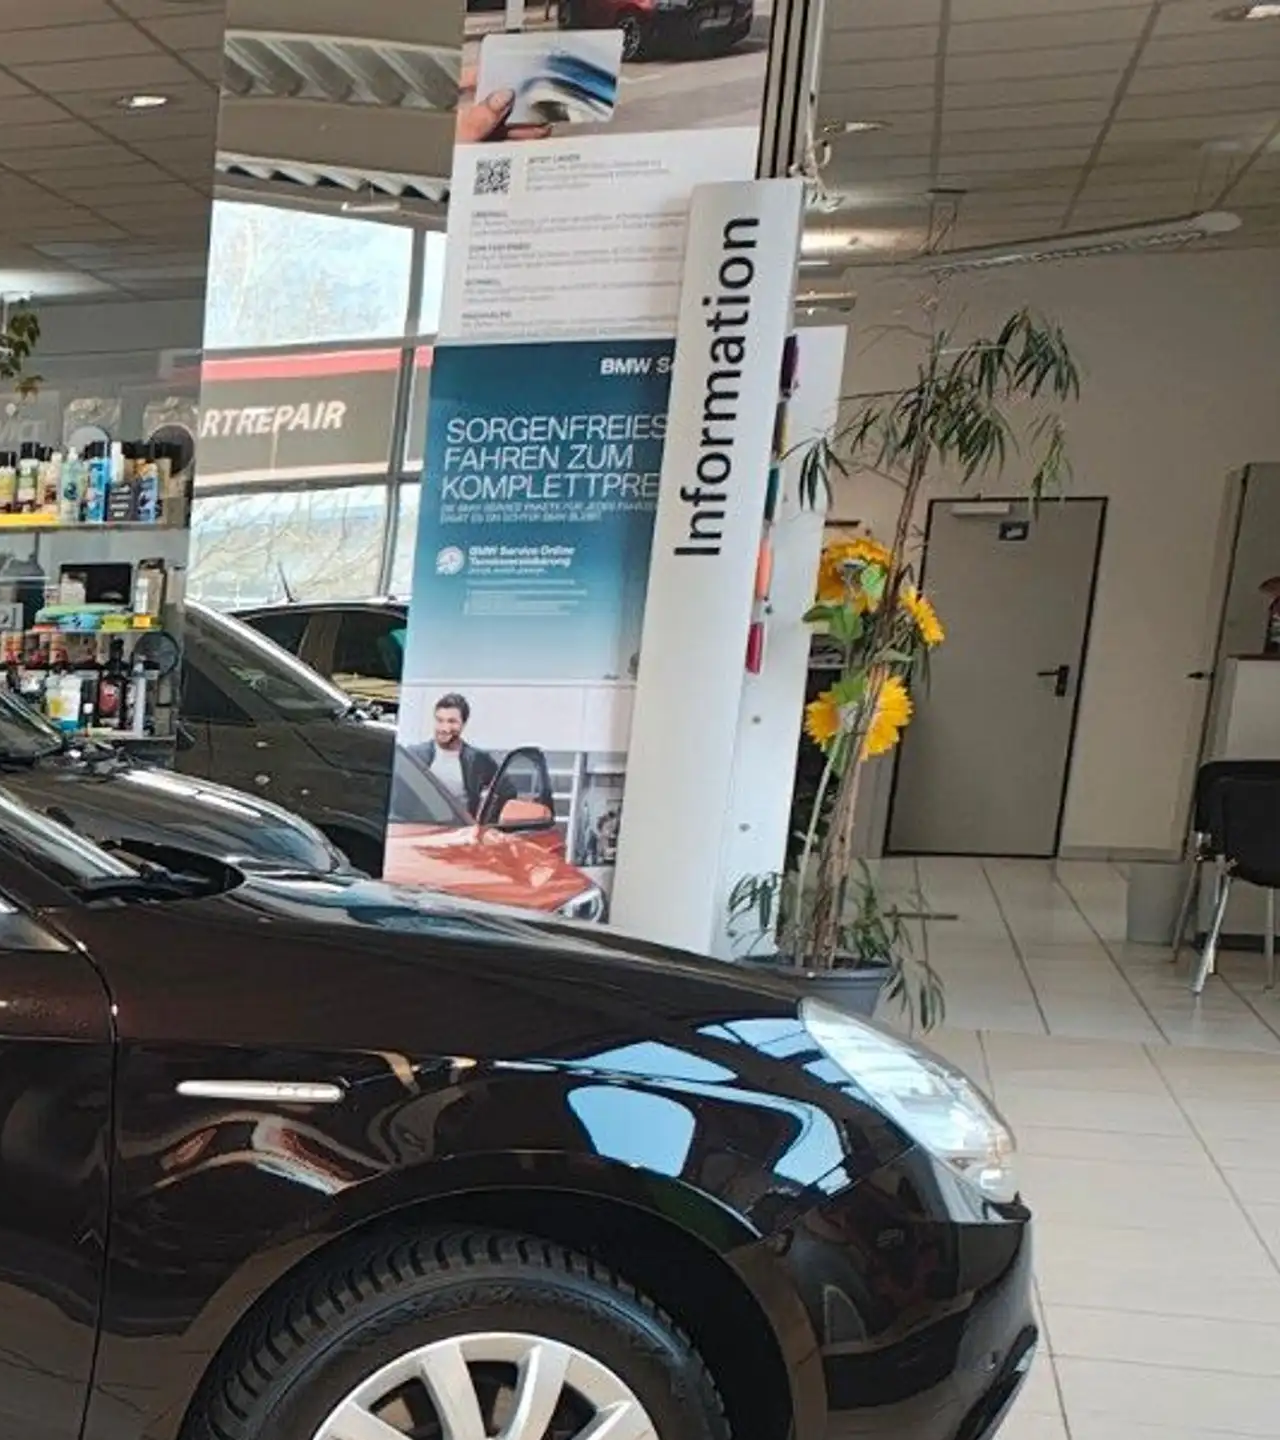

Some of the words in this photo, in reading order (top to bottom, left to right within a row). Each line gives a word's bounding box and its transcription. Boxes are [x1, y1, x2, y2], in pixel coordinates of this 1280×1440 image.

[600, 357, 651, 375] BMW
[674, 217, 760, 556] Information
[193, 400, 347, 437] RTREPAIR
[446, 414, 668, 444] SORGENFREIES
[444, 444, 561, 472] FAHREN
[566, 443, 634, 470] ZUM
